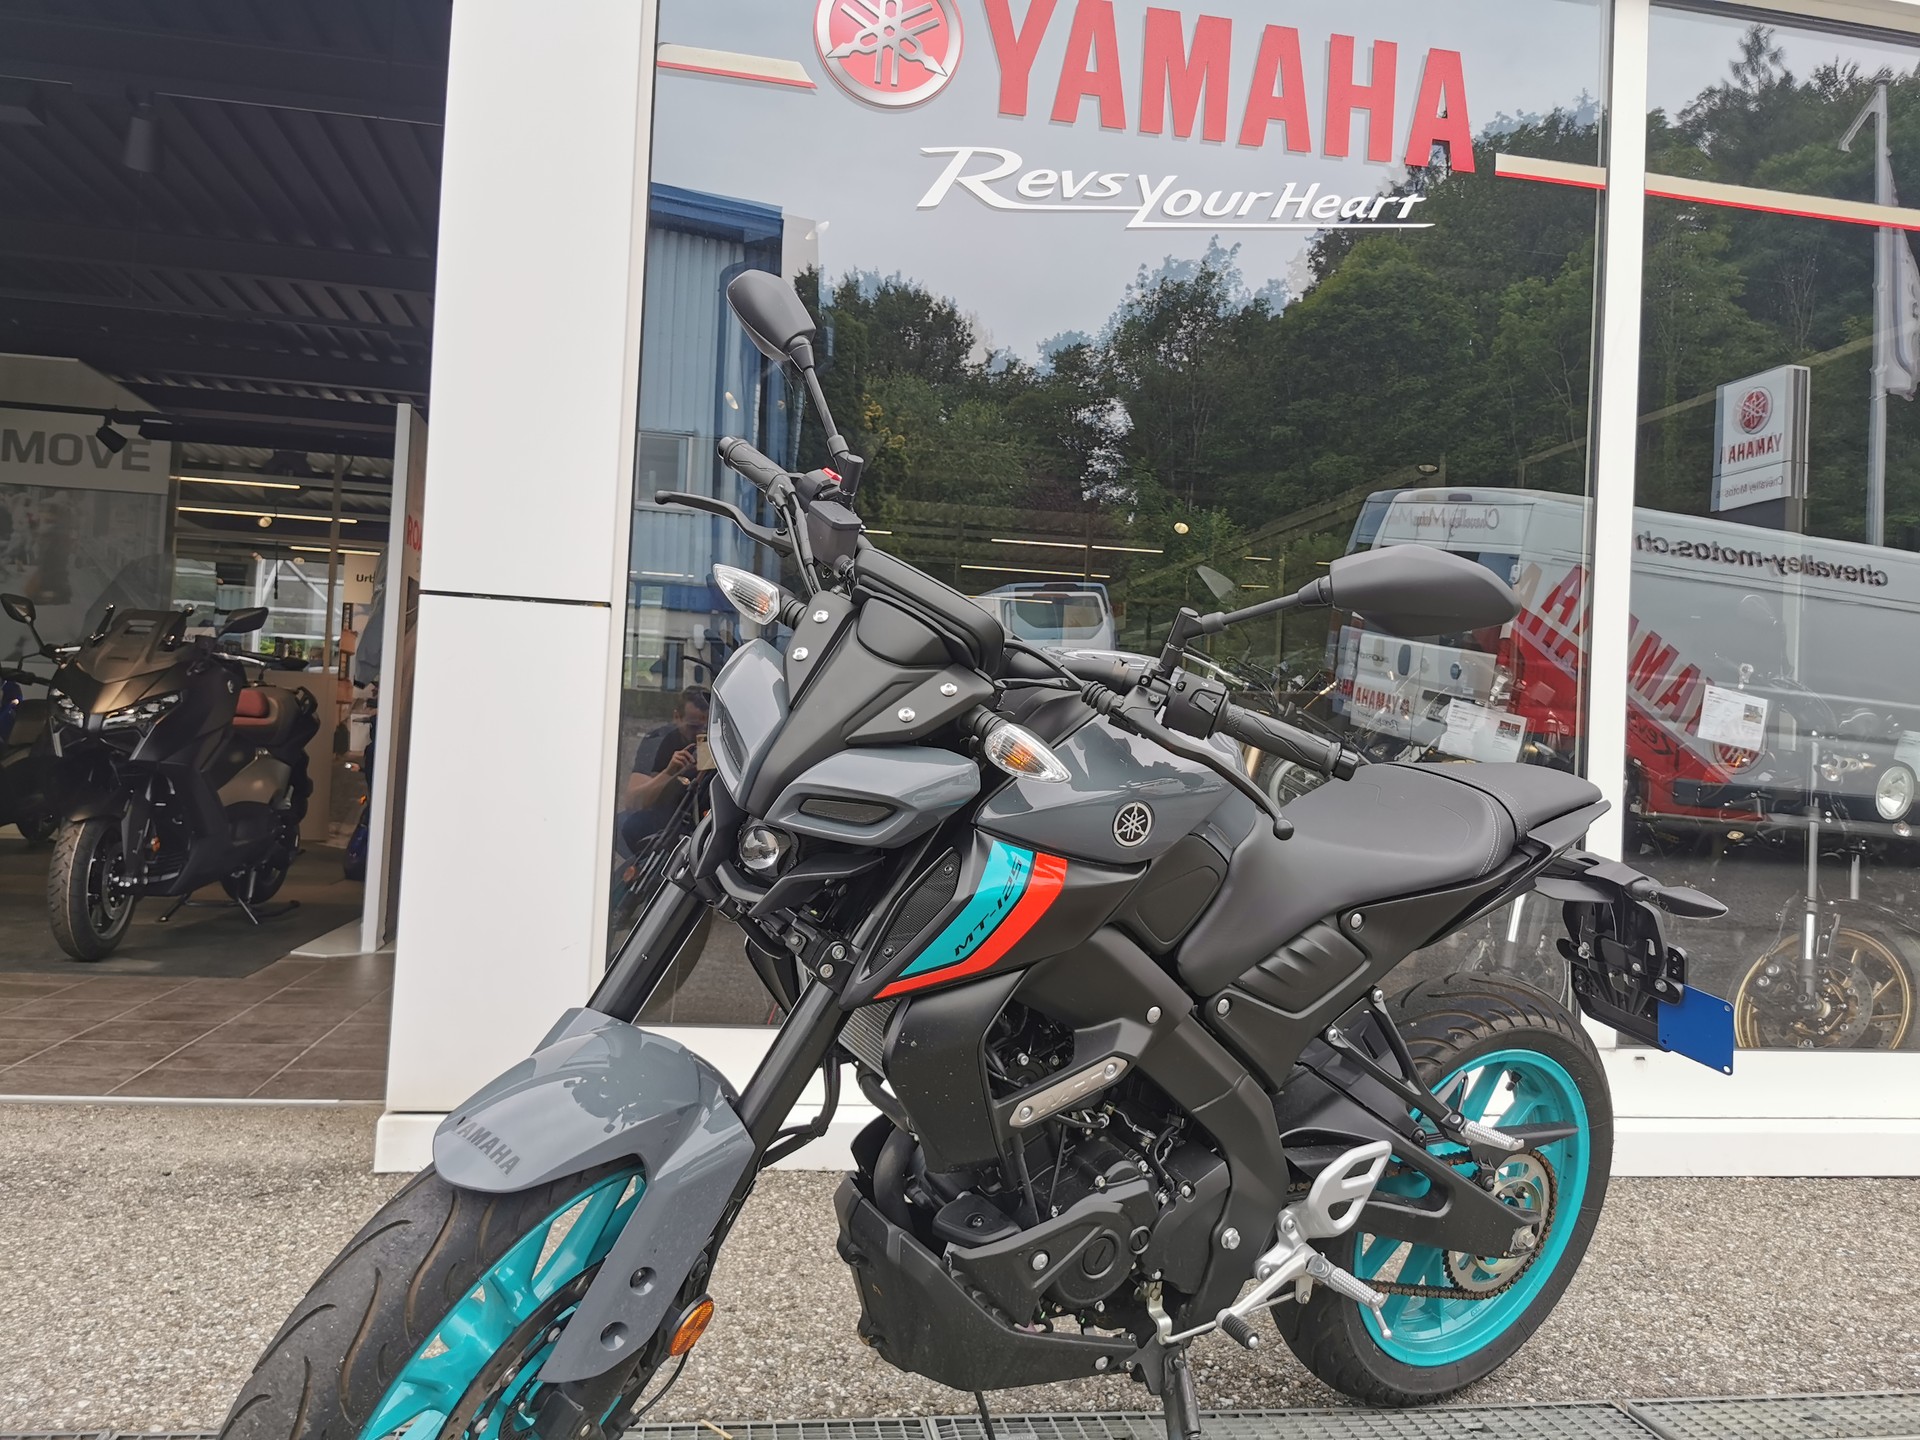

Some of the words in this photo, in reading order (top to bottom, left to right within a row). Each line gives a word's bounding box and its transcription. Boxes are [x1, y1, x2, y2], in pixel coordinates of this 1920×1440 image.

[980, 0, 1476, 173] YAMAHA
[917, 146, 1131, 210] Revs
[1125, 173, 1272, 229] Your
[1270, 181, 1428, 220] Heart
[954, 855, 1024, 957] MT-125
